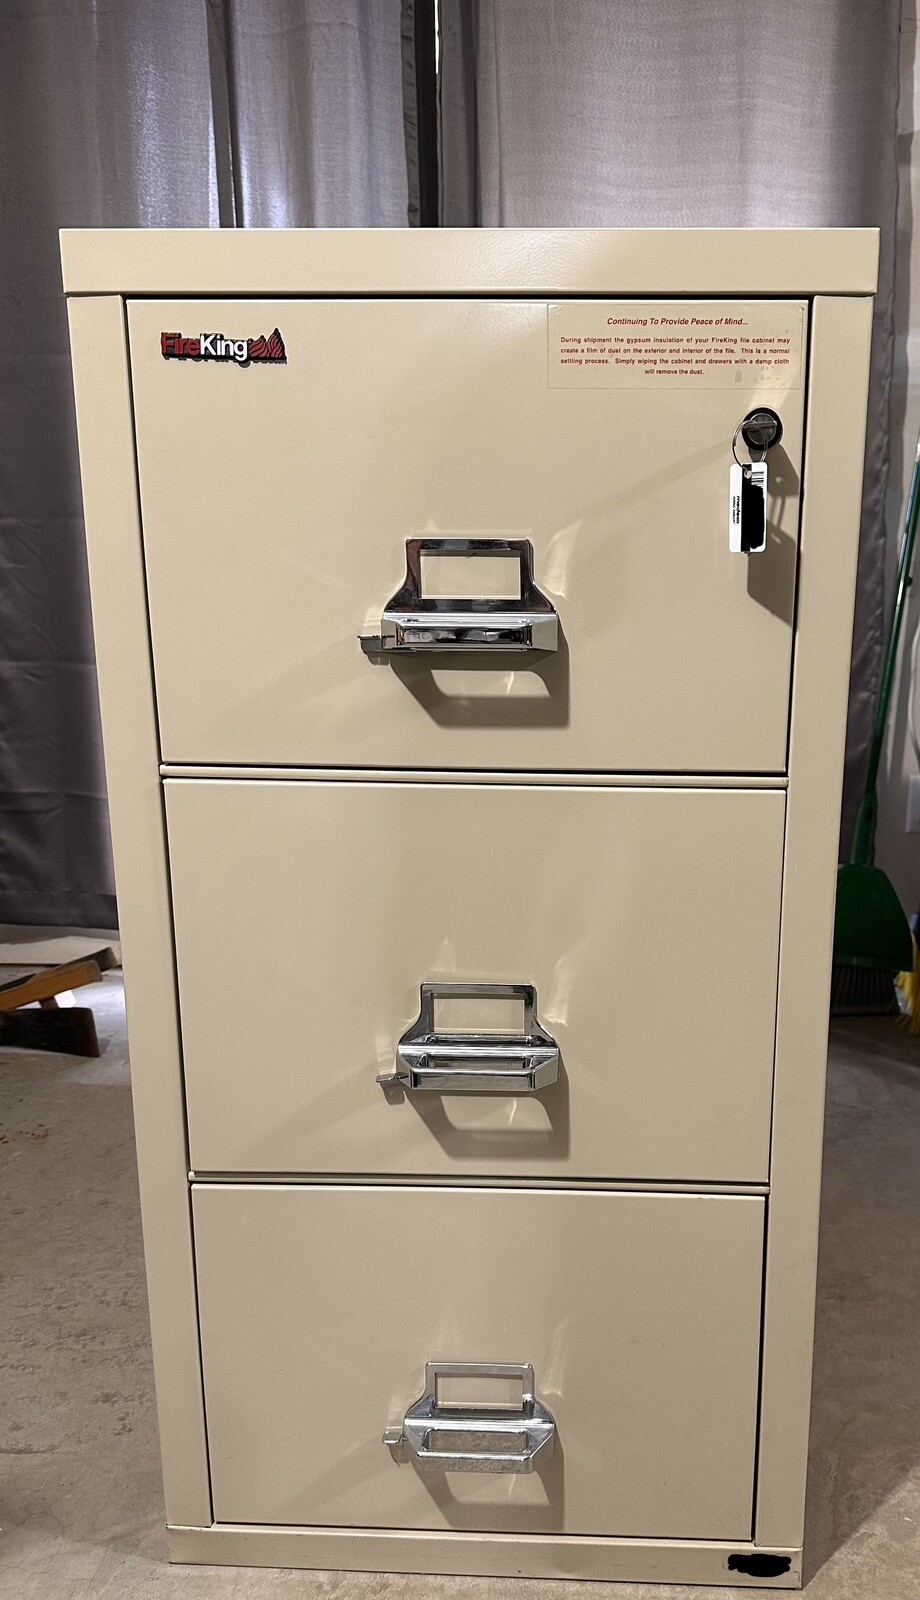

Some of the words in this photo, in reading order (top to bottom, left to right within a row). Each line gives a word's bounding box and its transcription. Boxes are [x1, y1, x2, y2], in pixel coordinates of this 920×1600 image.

[606, 318, 648, 326] Continuing
[650, 318, 660, 326] To
[660, 318, 690, 326] Provide
[690, 318, 714, 326] Peace
[714, 318, 724, 326] of
[560, 336, 582, 344] During
[584, 336, 612, 344] shipment
[712, 336, 738, 344] FireKing
[161, 332, 248, 361] FireKing
[560, 358, 582, 366] settling
[614, 358, 636, 366] Simply
[636, 358, 658, 366] wiping
